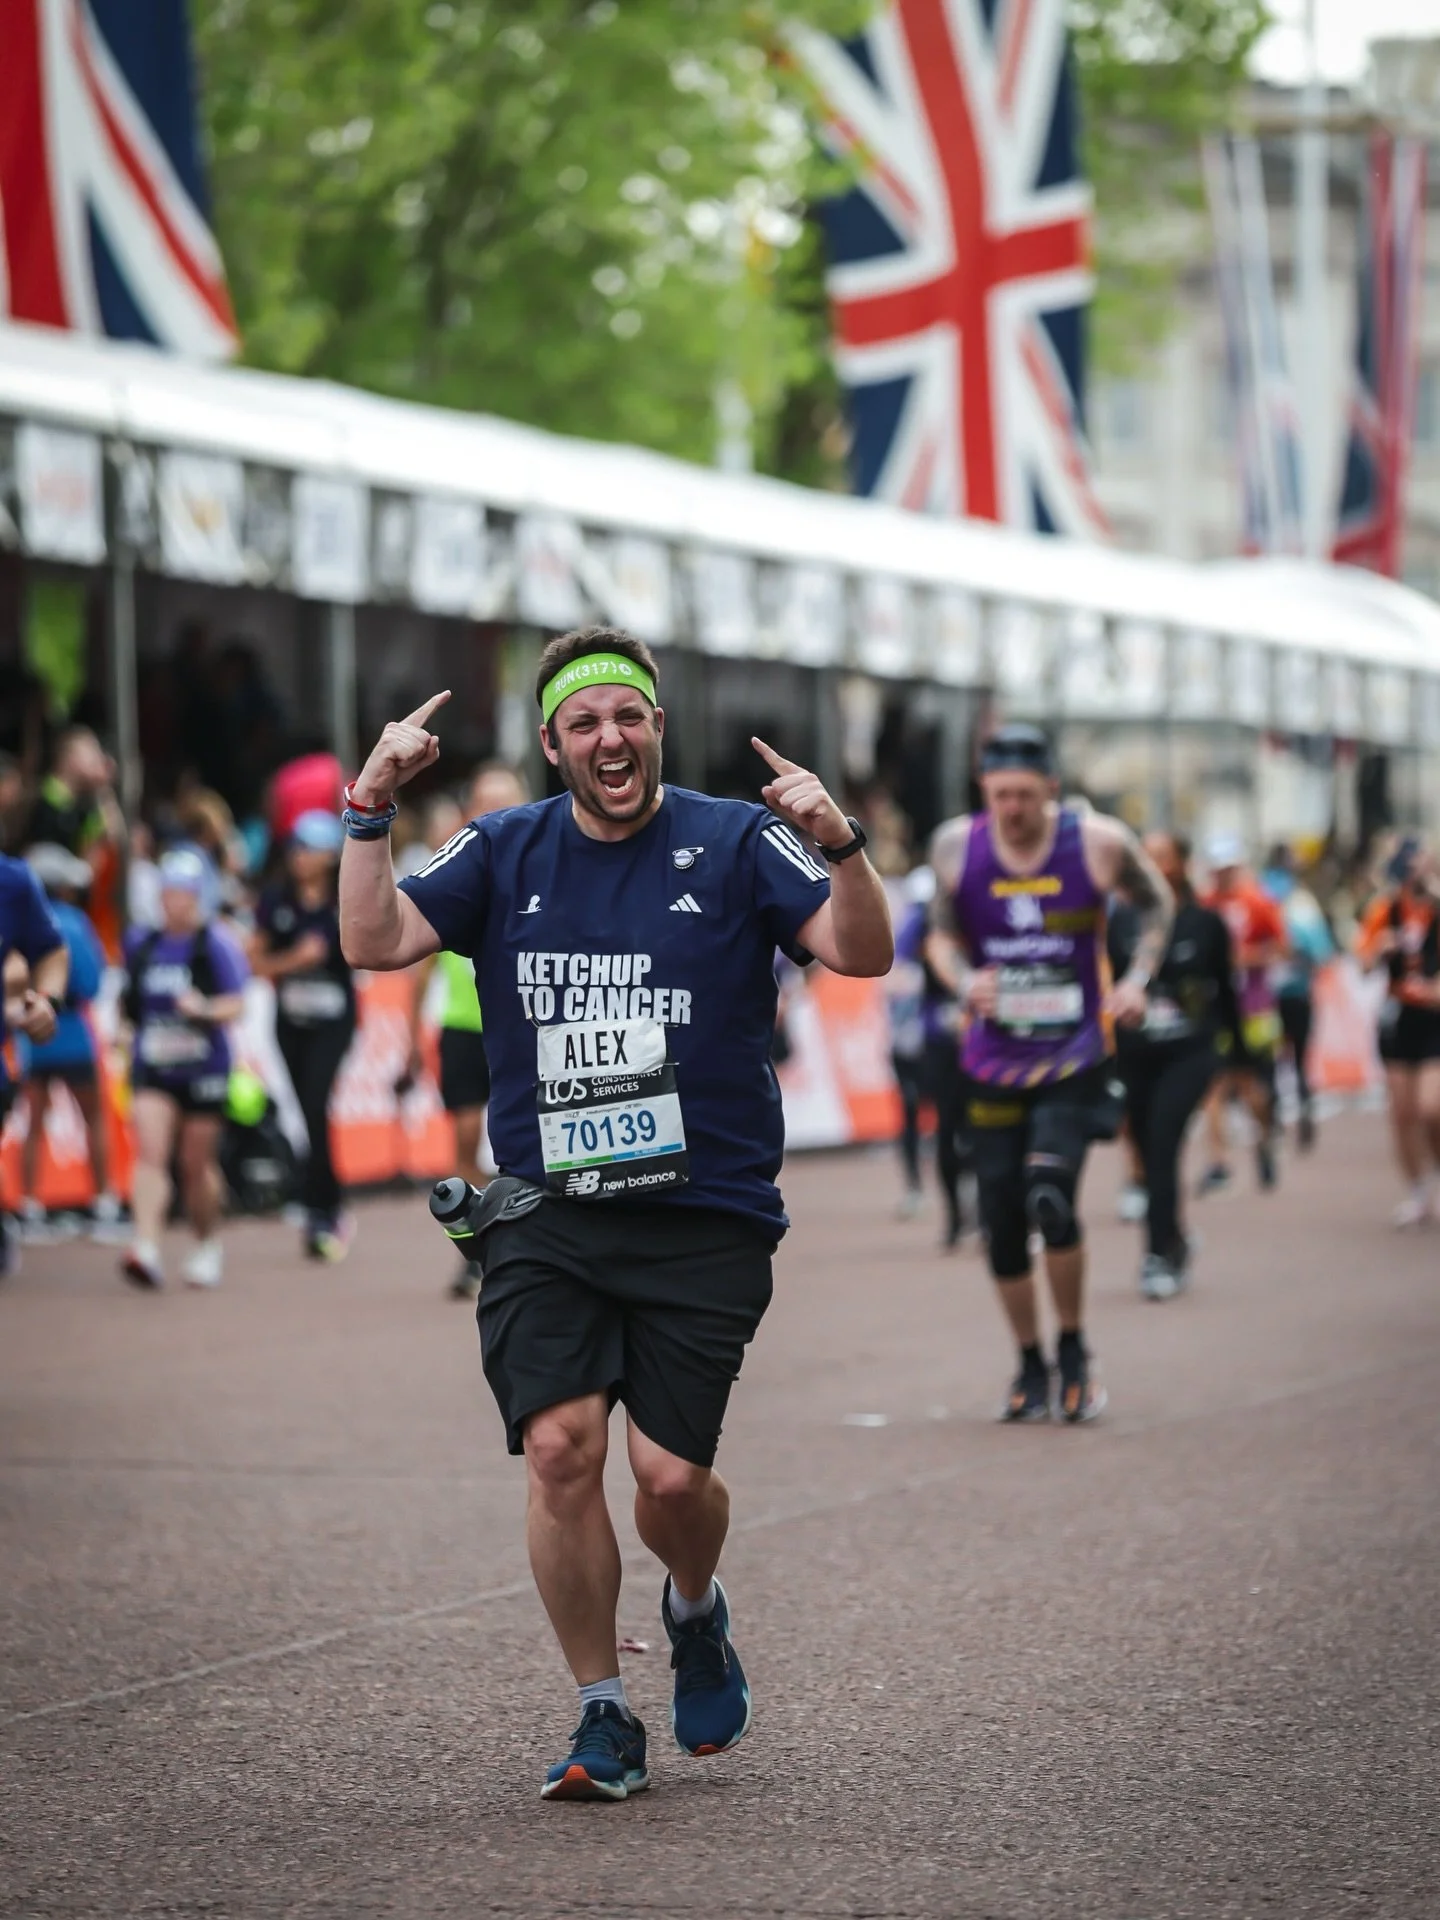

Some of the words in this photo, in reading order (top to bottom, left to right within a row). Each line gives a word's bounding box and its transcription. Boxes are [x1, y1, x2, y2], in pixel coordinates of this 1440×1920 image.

[517, 952, 652, 986] KETCHUP
[517, 985, 555, 1021] TO
[563, 986, 692, 1025] CANCER
[564, 1029, 629, 1070] ALEX
[592, 1081, 640, 1098] SERVICES
[560, 1110, 657, 1154] 70139
[603, 1179, 626, 1192] new
[627, 1170, 677, 1188] balance
